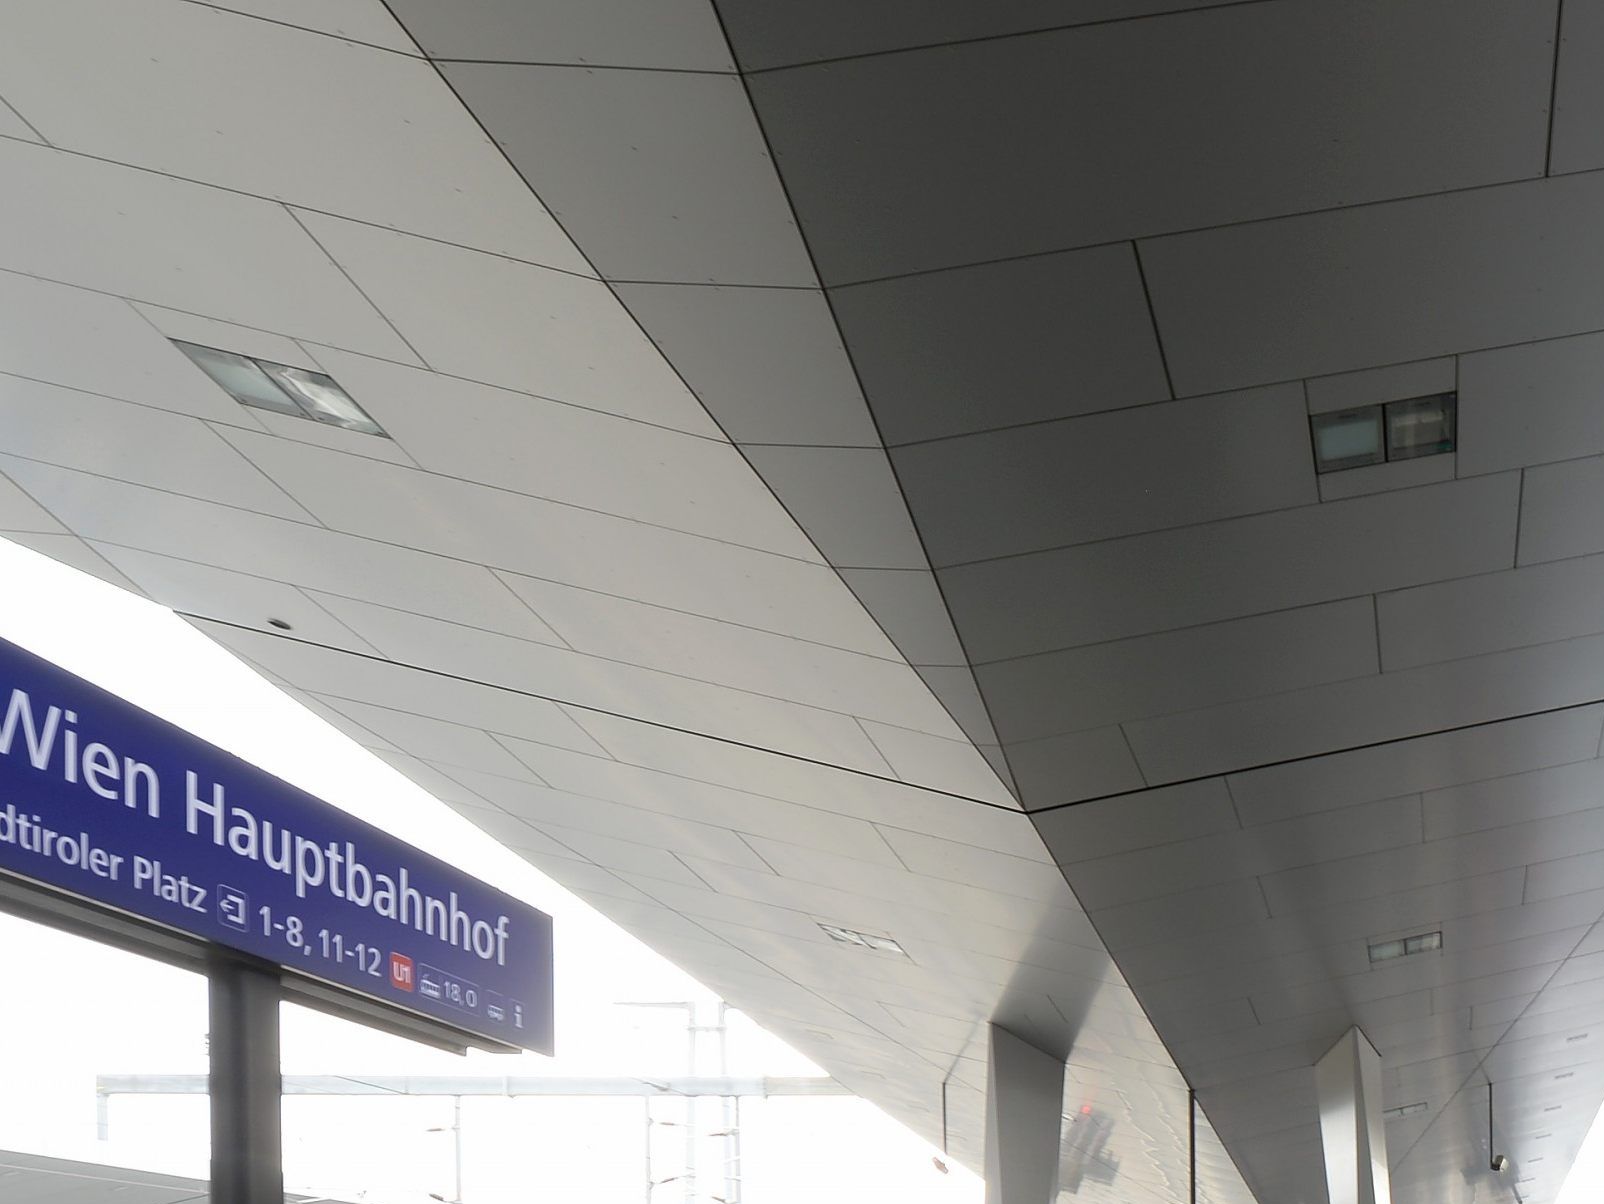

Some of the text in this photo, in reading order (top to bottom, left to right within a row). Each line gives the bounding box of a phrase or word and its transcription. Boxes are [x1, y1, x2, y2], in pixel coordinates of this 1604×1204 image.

[0, 688, 511, 967] Wien Hauptbahnhof
[133, 855, 208, 913] Platz
[259, 905, 312, 956] 1-8,
[318, 929, 382, 977] 11-12
[393, 961, 412, 985] U1
